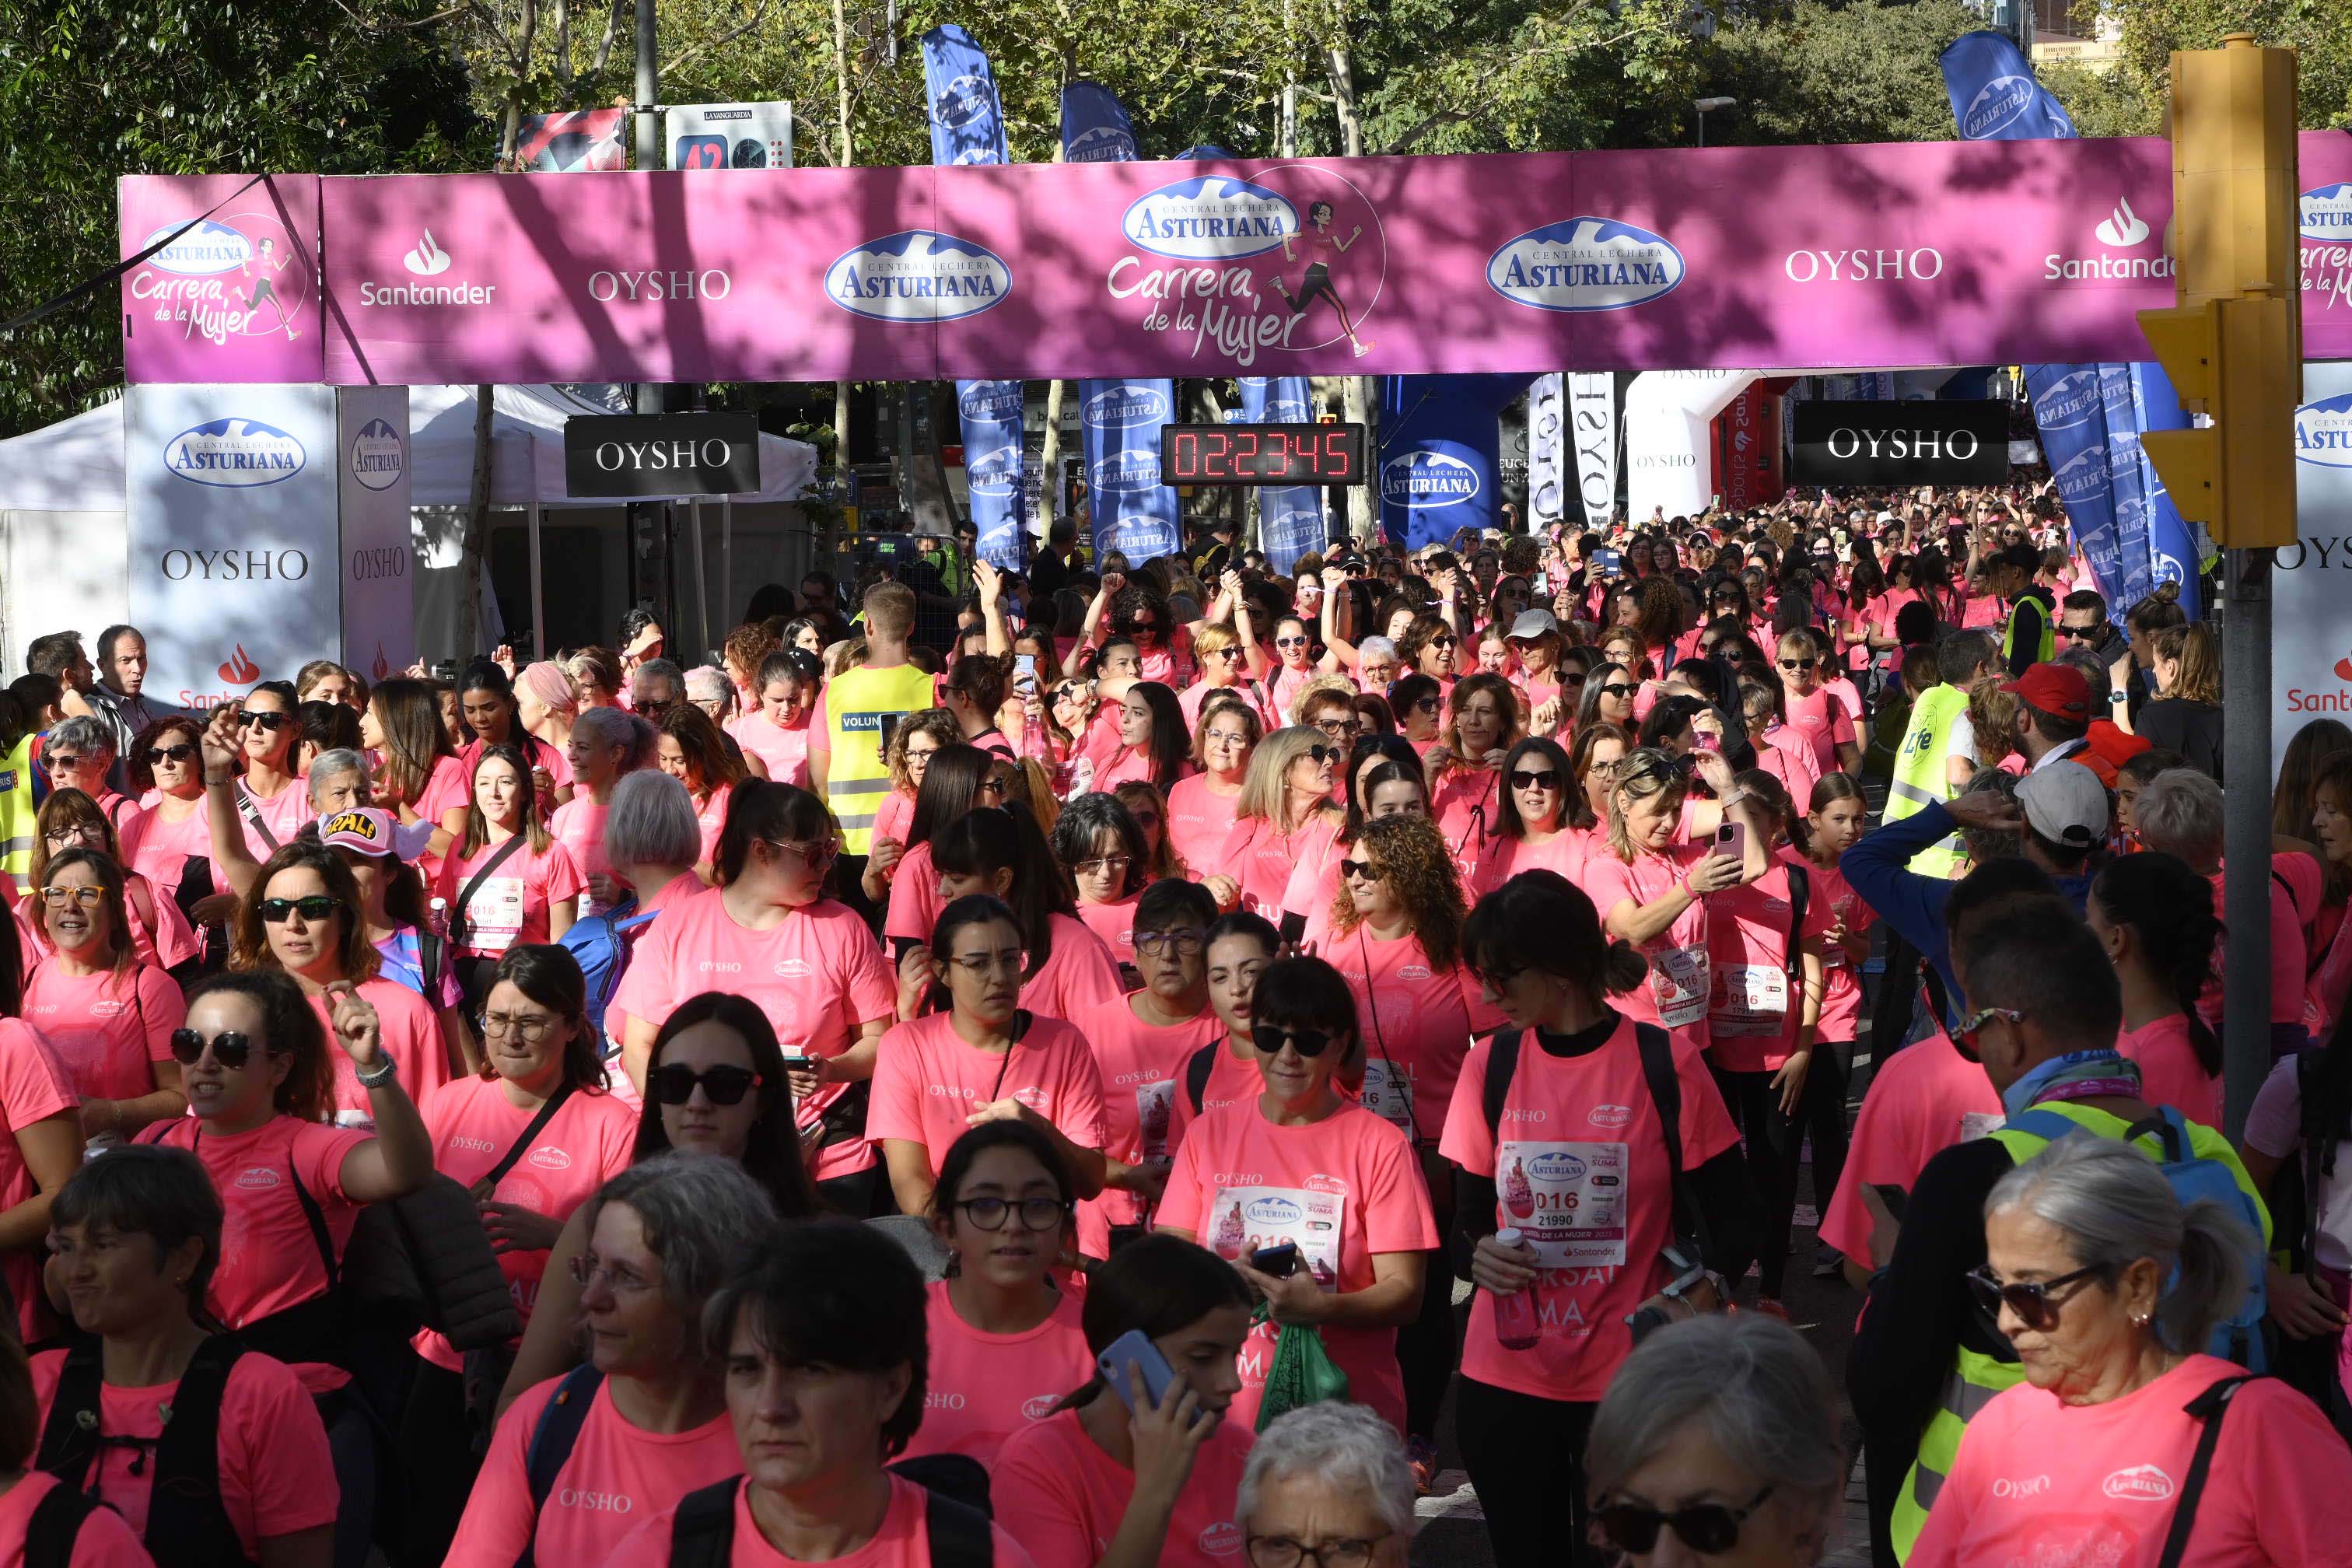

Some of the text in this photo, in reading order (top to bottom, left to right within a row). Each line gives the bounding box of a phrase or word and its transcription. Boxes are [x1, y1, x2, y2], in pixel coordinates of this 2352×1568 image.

[1163, 204, 1280, 213] CENTRAL LECHERA
[1136, 208, 1284, 240] ASTURIANA
[150, 240, 243, 261] ASTURIANA
[1532, 248, 1662, 260] CENTRAL LECHERA
[868, 261, 990, 272] CENTRAL LECHERA
[1107, 255, 1252, 299] Carrera
[1502, 254, 1669, 288] ASTURIANA
[1785, 247, 1943, 282] OYSHO
[131, 271, 223, 299] Carrera
[588, 268, 730, 303] OYSHO
[839, 265, 997, 299] ASTURIANA
[2317, 268, 2331, 291] la
[360, 281, 495, 306] Santander
[154, 299, 258, 345] de la Mujer
[1143, 294, 1307, 366] de la Mujer
[596, 438, 730, 471] OYSHO
[1175, 432, 1349, 476] 02:23:45
[1828, 428, 1979, 460] OYSHO
[174, 443, 297, 471] ASTURIANA
[355, 446, 401, 474] ASTURIANA
[1637, 453, 1696, 468] OYSHO
[1384, 474, 1472, 495] ASTURIANA
[160, 548, 309, 581] OYSHO
[352, 545, 404, 581] OYSHO
[324, 813, 374, 840] ARALE
[1176, 814, 1204, 824] OYSHO
[699, 961, 741, 971] OYSHO
[1731, 993, 1759, 1005] 016
[1115, 1069, 1160, 1085] OYSHO
[1591, 1112, 1632, 1122] ASTURIANA
[1531, 1164, 1582, 1175] ASTURIANA
[1250, 1206, 1297, 1220] ASTURIANA
[1535, 1192, 1580, 1210] 016
[1538, 1215, 1573, 1227] 21990
[1573, 1248, 1616, 1258] Santander
